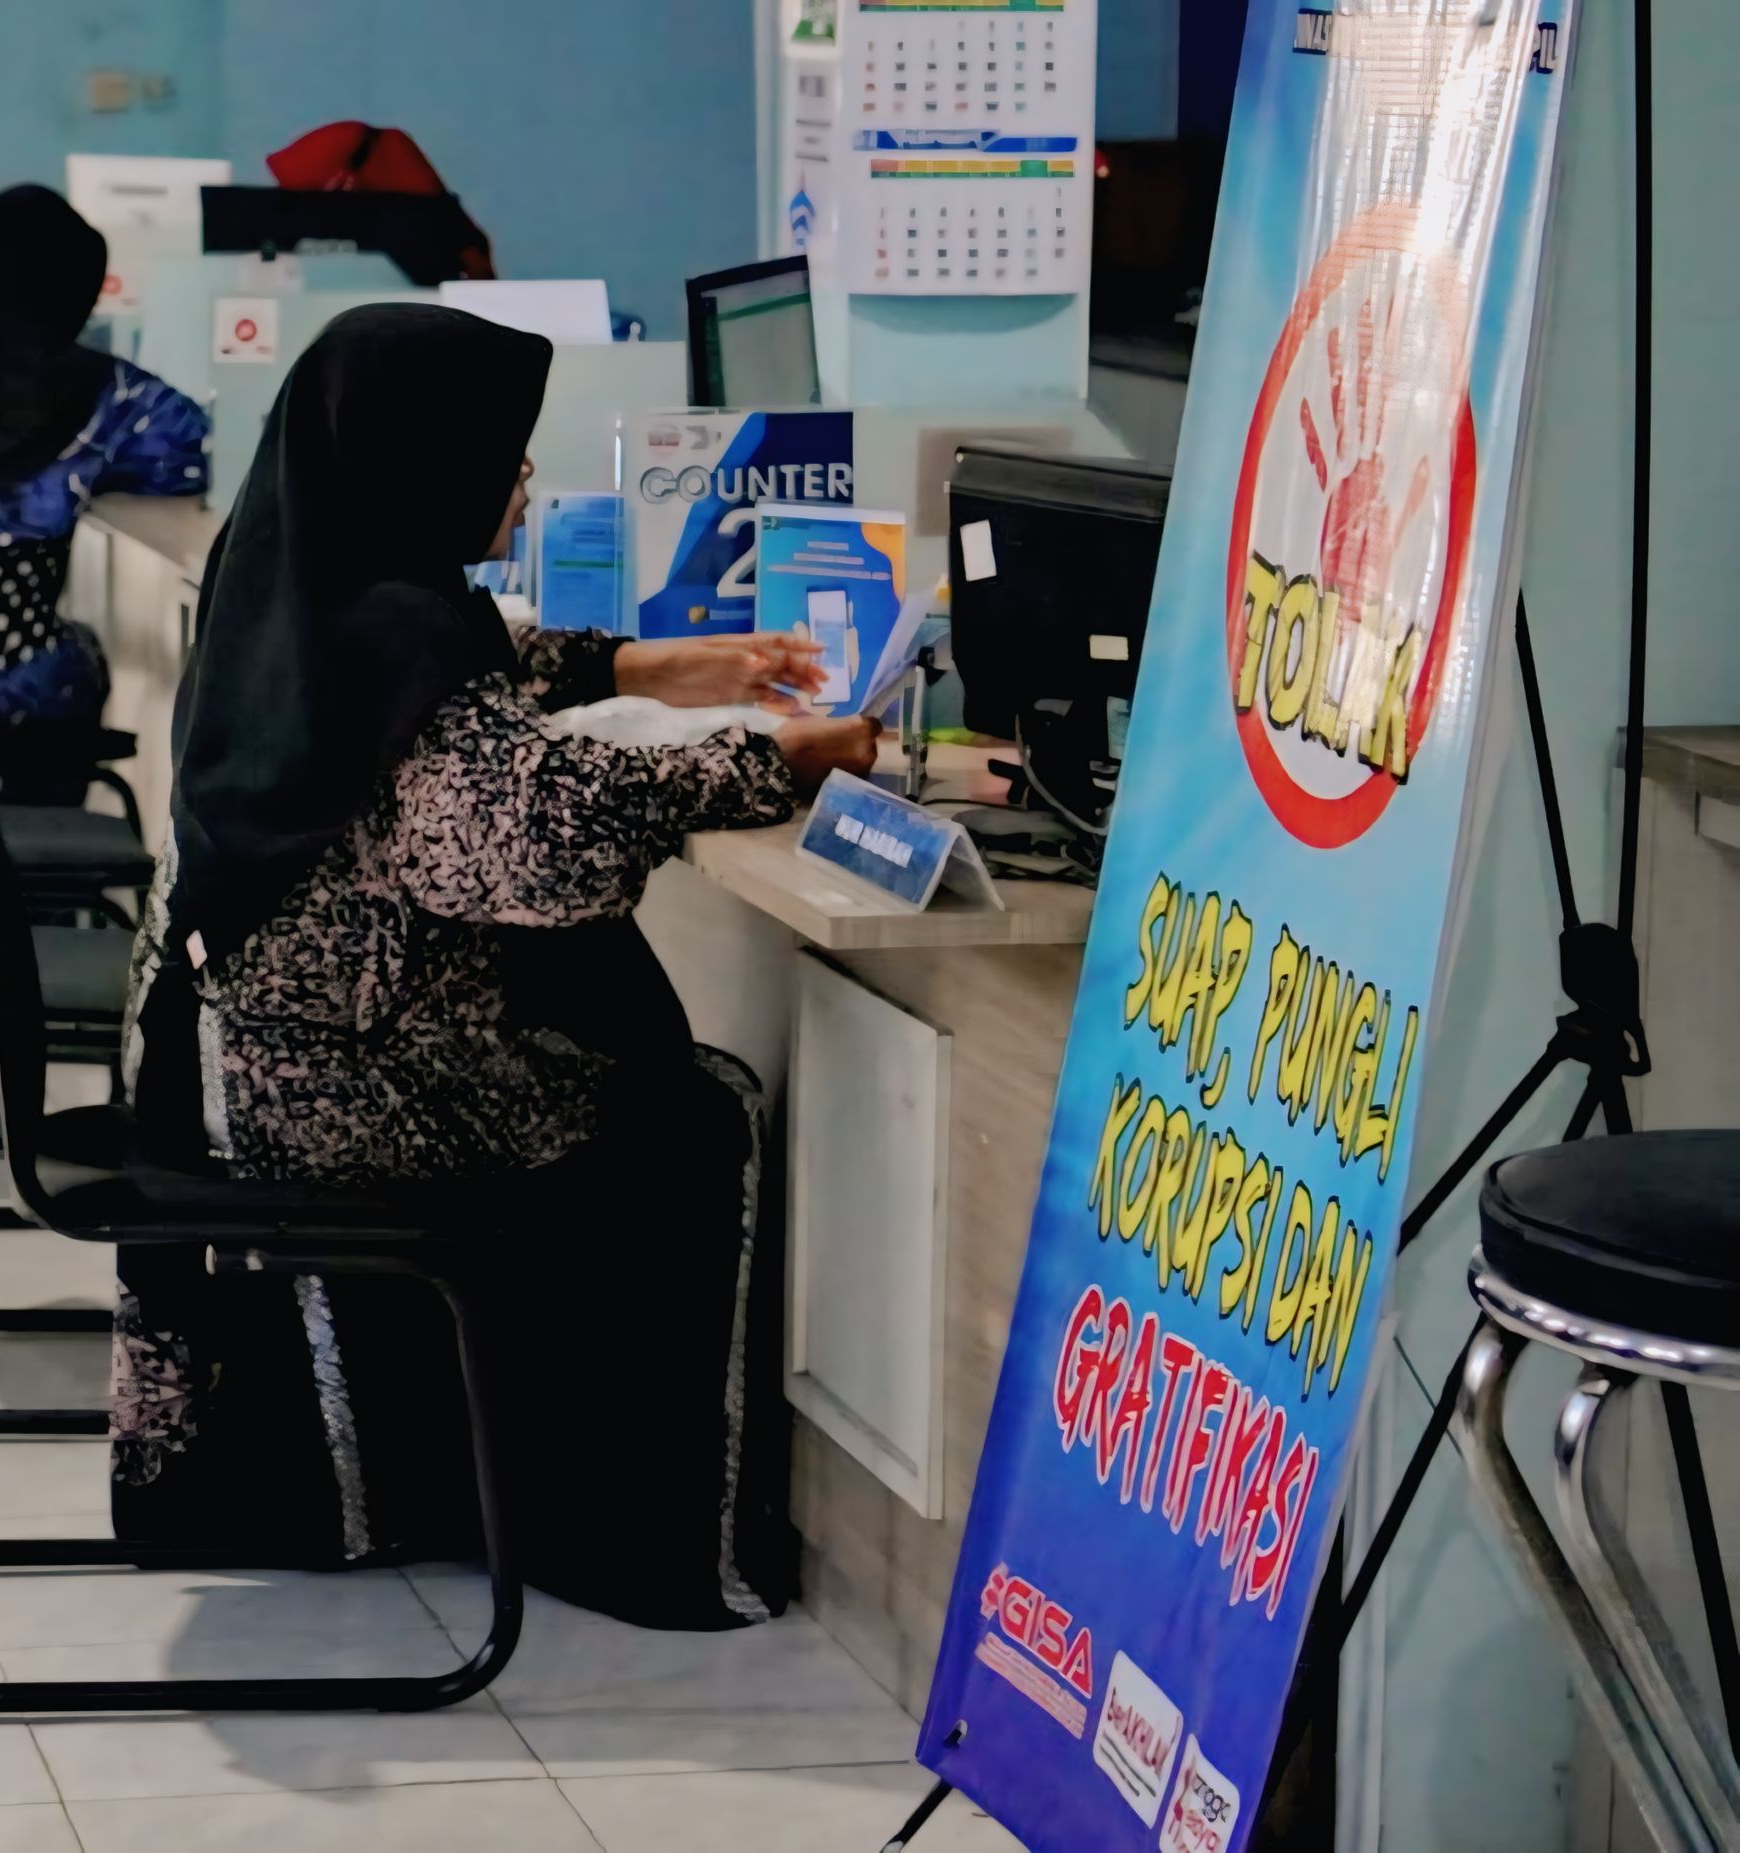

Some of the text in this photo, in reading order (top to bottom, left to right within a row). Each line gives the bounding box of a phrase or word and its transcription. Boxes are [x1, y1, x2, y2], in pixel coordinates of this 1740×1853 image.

[640, 462, 854, 503] COUNTER
[717, 507, 756, 599] 2
[1124, 870, 1419, 1186] SUAP, PUNGLI
[1087, 1072, 1373, 1403] KORUPSI DAN
[1054, 1283, 1320, 1621] GRATIFIKASI
